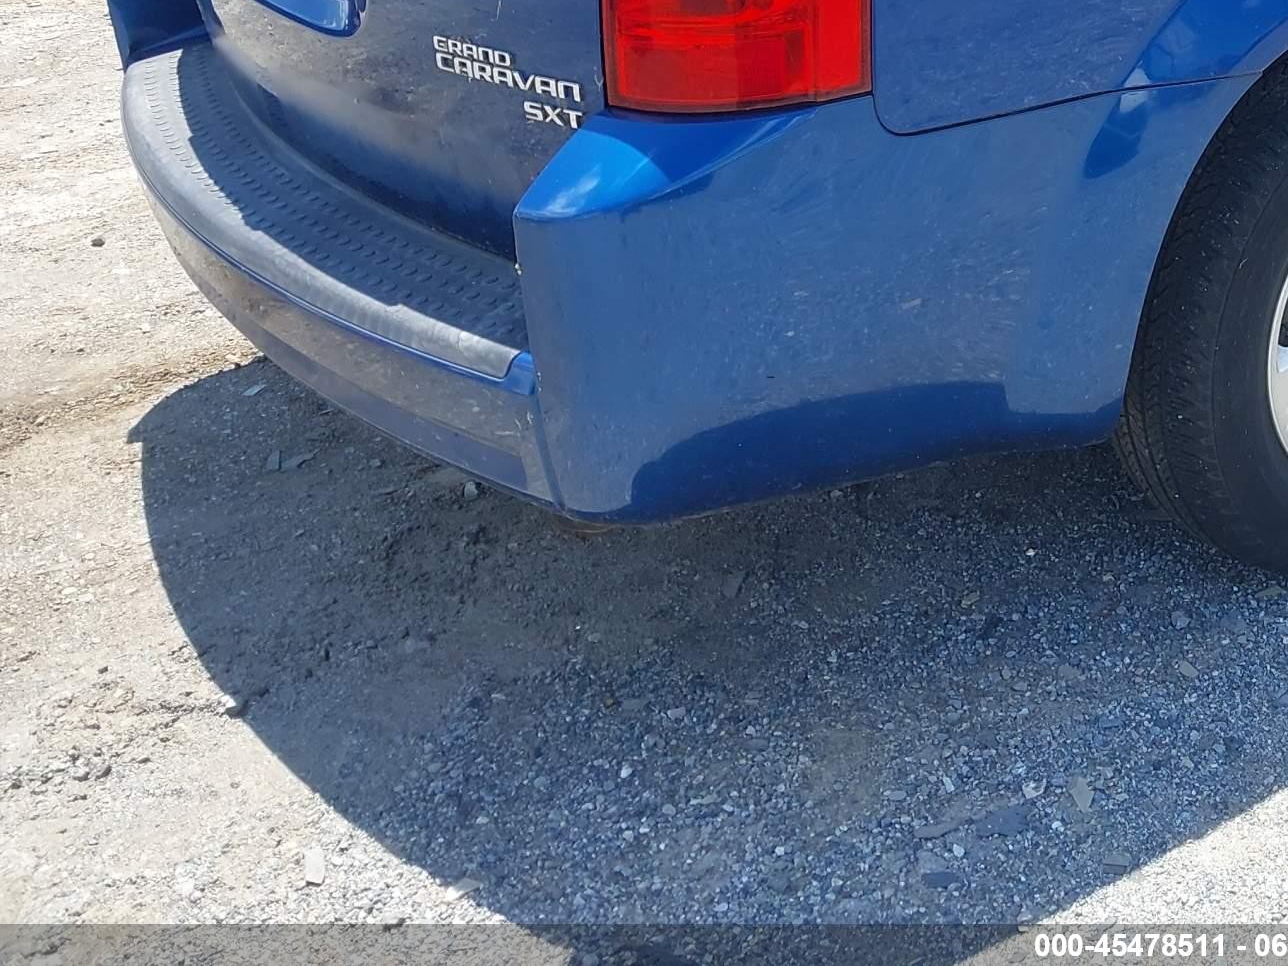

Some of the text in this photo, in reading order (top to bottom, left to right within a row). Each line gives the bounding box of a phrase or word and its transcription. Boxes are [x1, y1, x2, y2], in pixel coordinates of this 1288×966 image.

[432, 35, 512, 68] GRAND
[435, 52, 583, 103] CARAVAN
[523, 100, 583, 130] SXT
